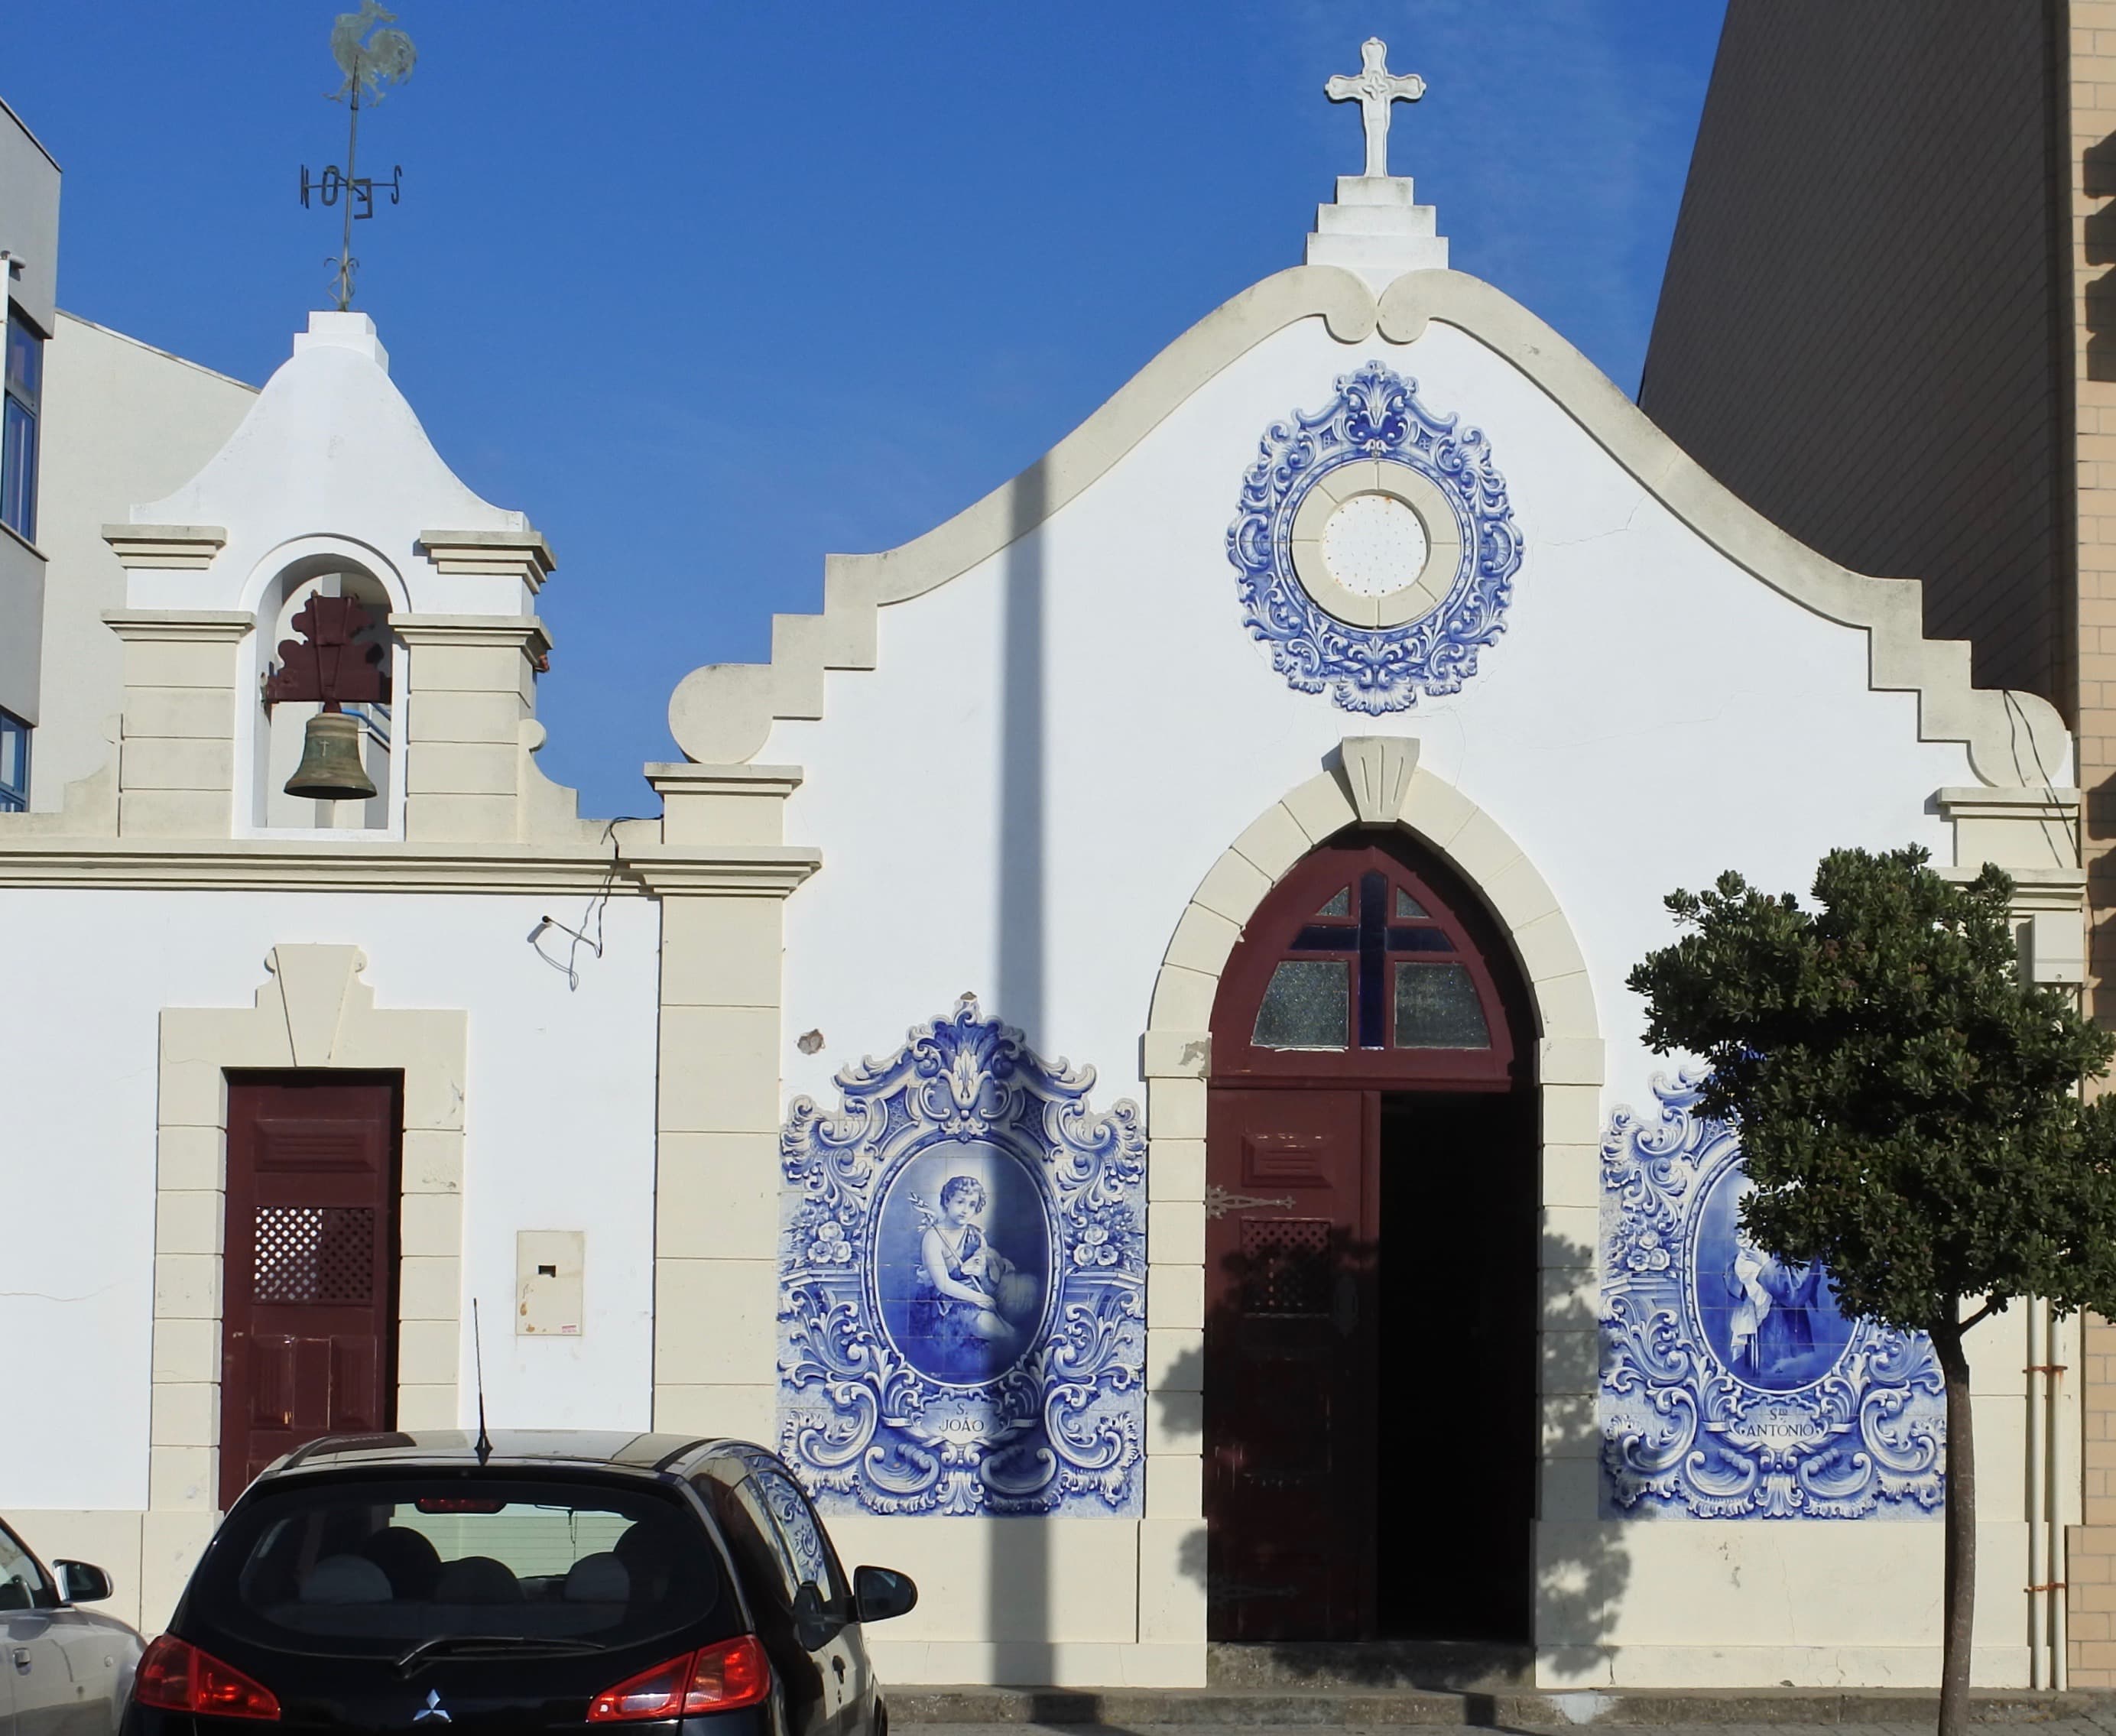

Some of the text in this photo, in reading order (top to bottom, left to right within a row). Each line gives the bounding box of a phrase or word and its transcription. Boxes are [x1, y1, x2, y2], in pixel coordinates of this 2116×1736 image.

[321, 165, 339, 206] O
[939, 1417, 985, 1432] JOÃO
[1747, 1420, 1814, 1437] ANTÓNIO
